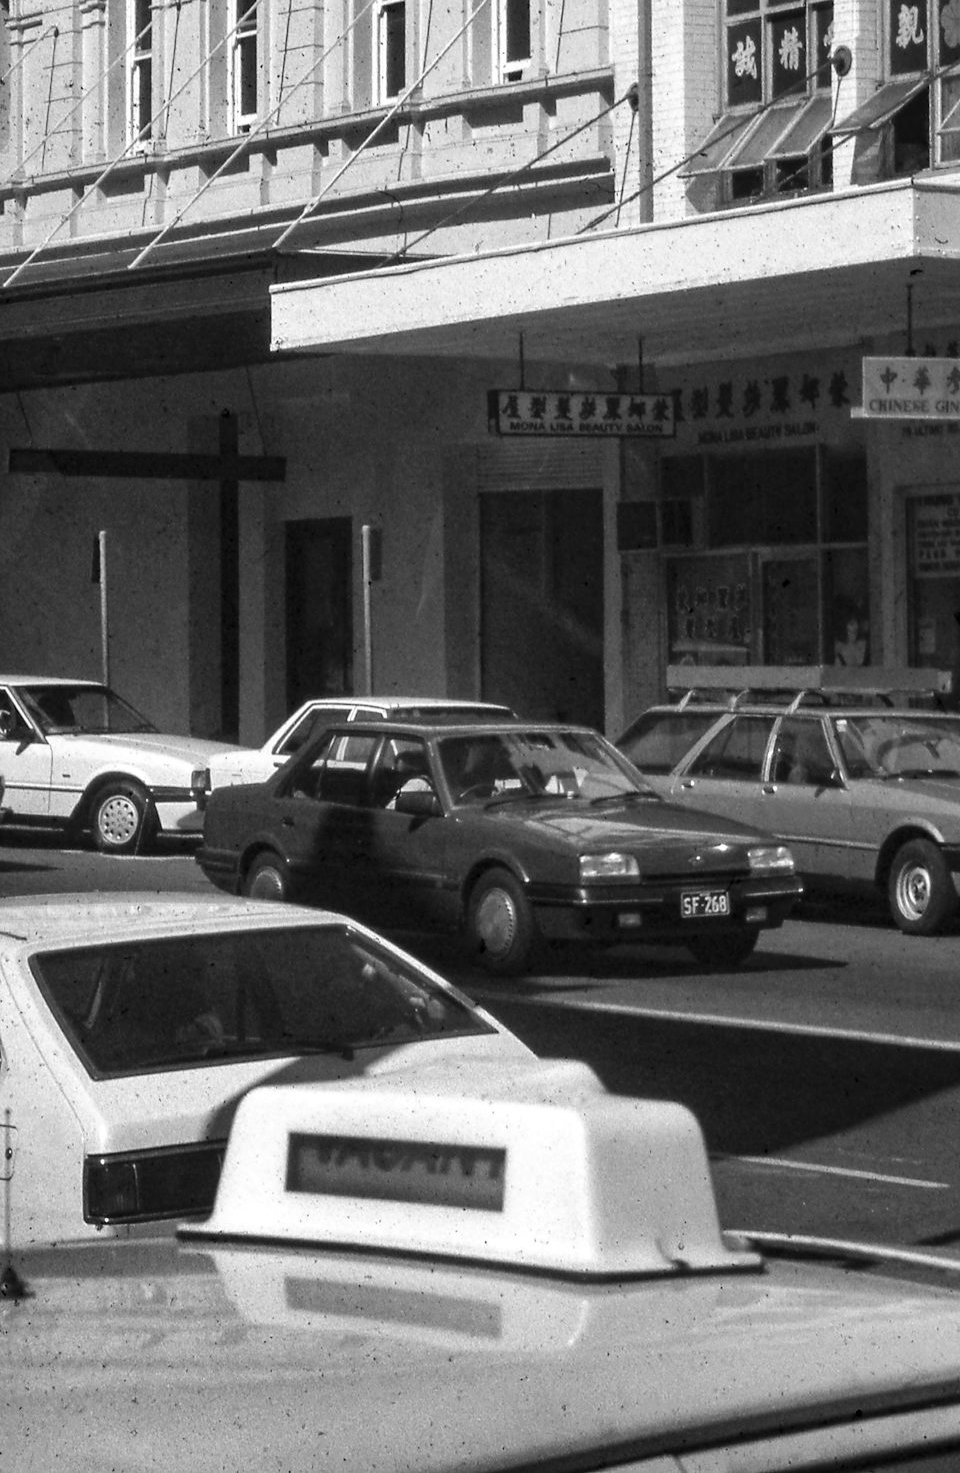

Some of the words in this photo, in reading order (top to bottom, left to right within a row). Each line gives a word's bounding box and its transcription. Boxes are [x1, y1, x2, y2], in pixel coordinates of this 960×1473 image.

[869, 398, 929, 413] CHINESE
[510, 422, 546, 432] MONA
[550, 422, 574, 432] LISA
[579, 422, 623, 433] BEAUTY
[626, 423, 663, 433] SALON
